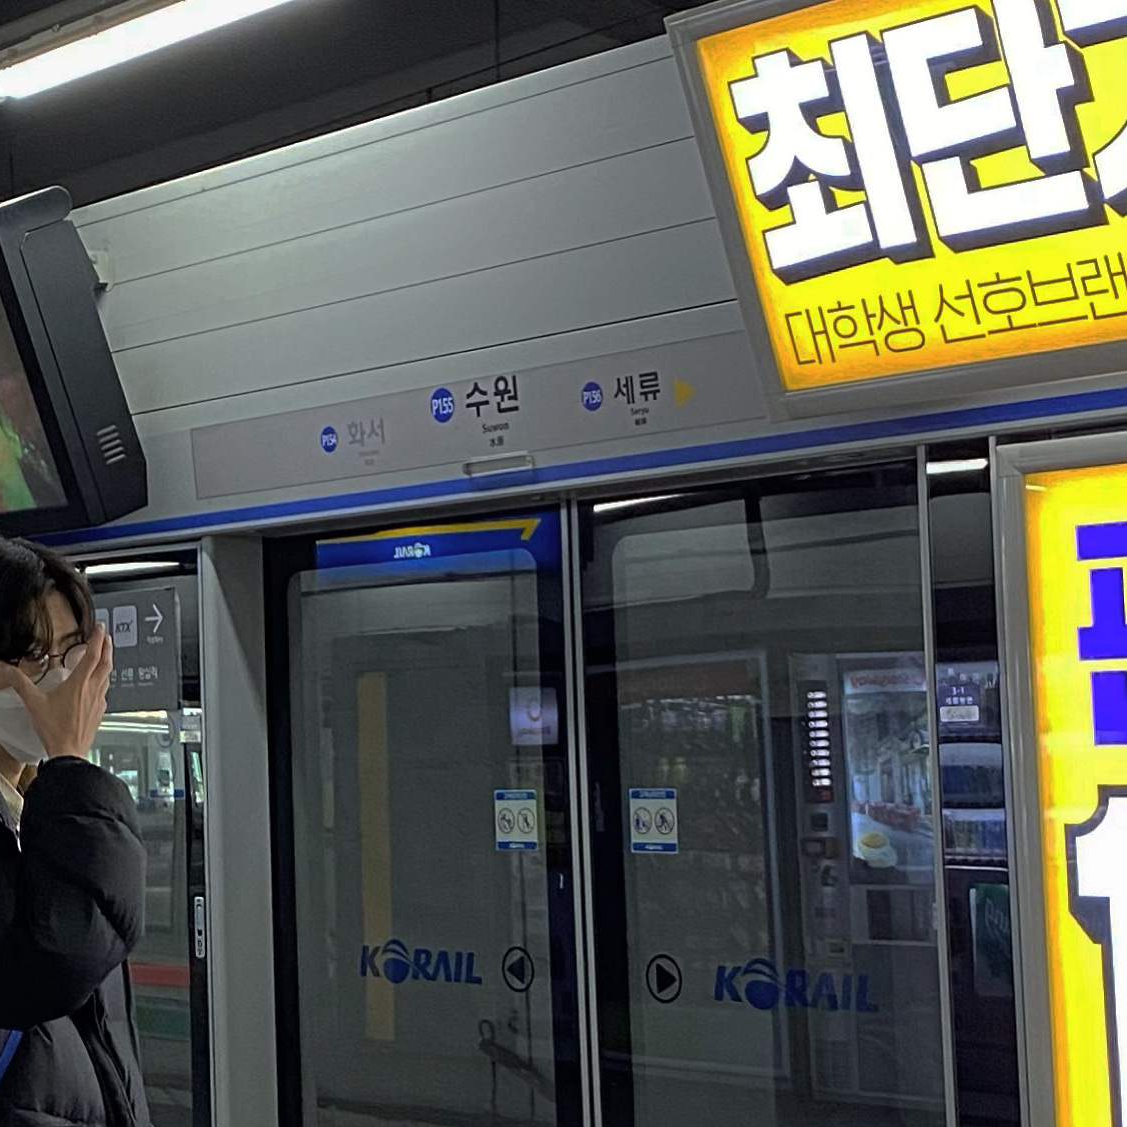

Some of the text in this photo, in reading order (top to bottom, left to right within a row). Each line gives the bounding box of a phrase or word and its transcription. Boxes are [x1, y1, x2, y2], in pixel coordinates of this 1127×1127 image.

[784, 289, 926, 366] 대학생
[432, 393, 454, 416] P155
[465, 374, 520, 418] 수원
[614, 371, 661, 405] 세류
[347, 417, 385, 448] 화서
[482, 422, 510, 434] Suwon
[115, 621, 134, 633] KTX
[360, 939, 483, 986] KORAIL
[713, 957, 880, 1012] KORAIL
